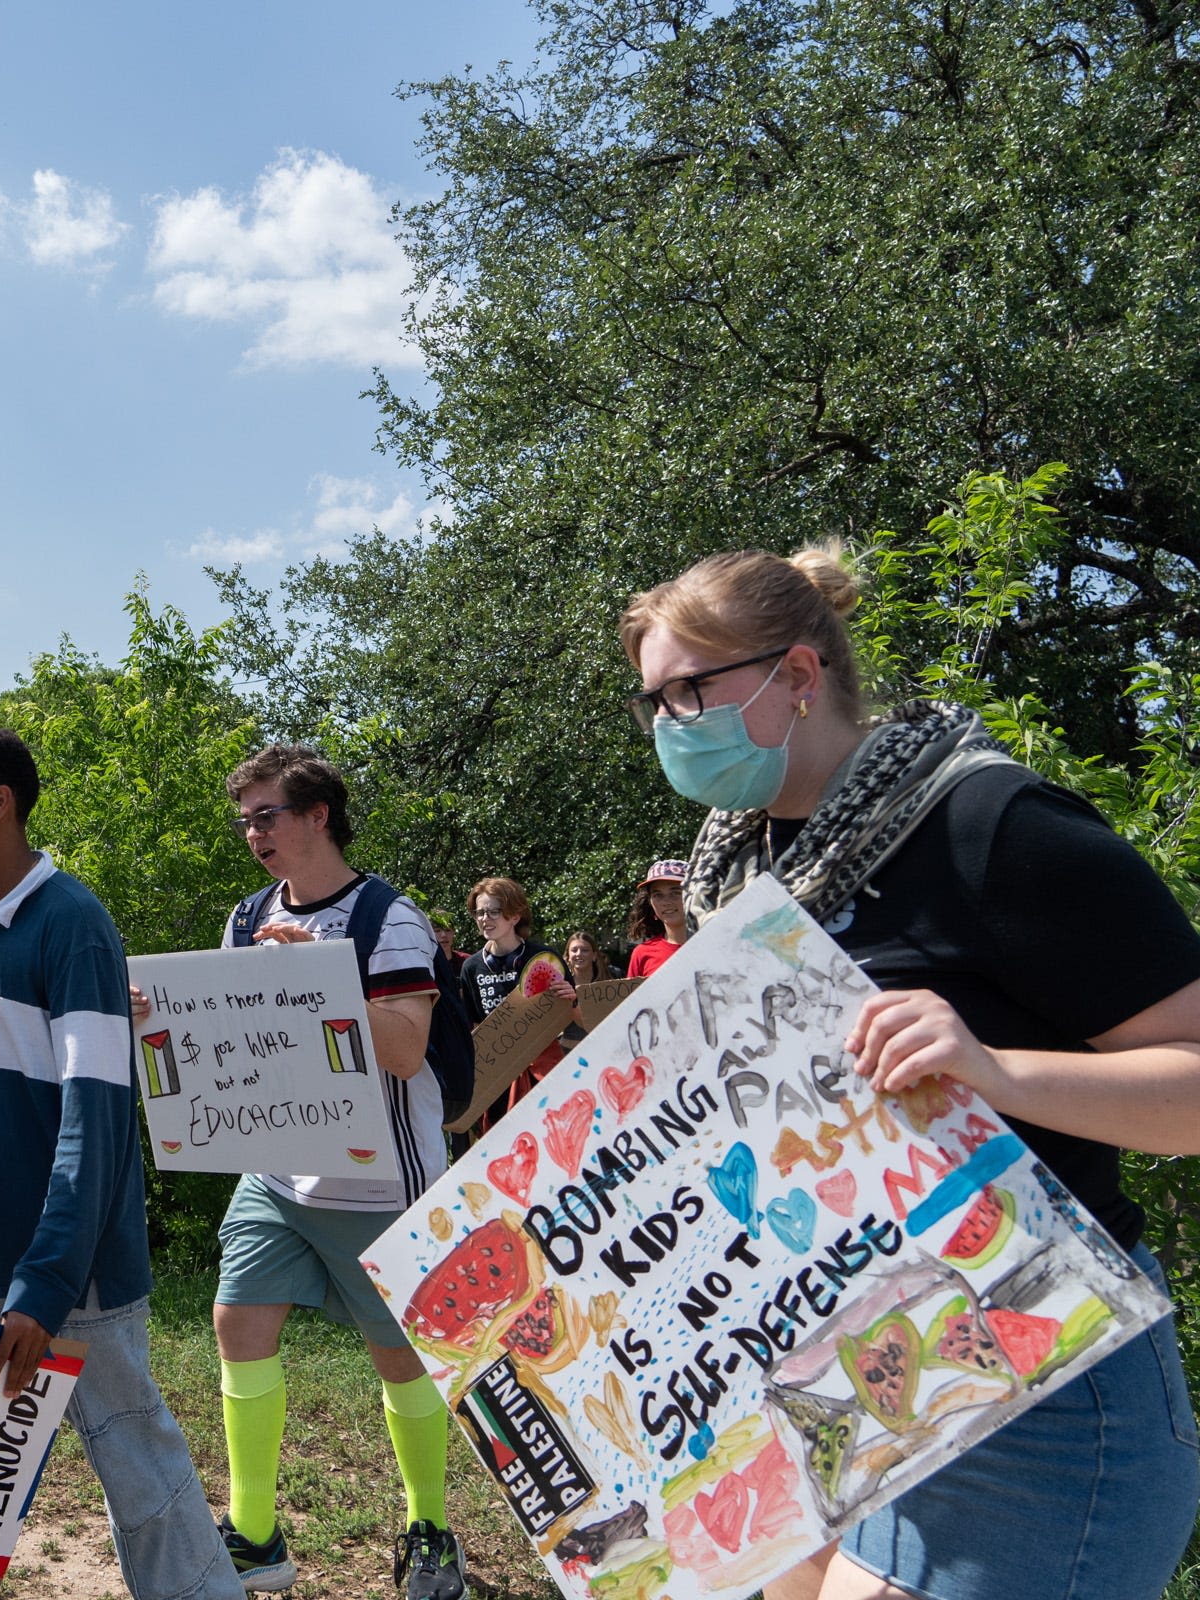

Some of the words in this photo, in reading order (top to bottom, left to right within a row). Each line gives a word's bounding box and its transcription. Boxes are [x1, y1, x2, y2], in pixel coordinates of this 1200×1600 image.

[476, 971, 518, 986] Gender
[479, 986, 487, 998] is
[487, 986, 495, 996] a
[153, 985, 196, 1015] How
[203, 998, 217, 1011] is
[226, 991, 265, 1010] there
[276, 988, 326, 1013] always
[481, 994, 506, 1010] Soci
[485, 1001, 516, 1031] WAR
[180, 1031, 201, 1066] $
[245, 1031, 298, 1058] WAR
[215, 1076, 234, 1091] but
[243, 1070, 260, 1086] not
[523, 1076, 719, 1276] BOMBING
[599, 1186, 704, 1287] KIDS
[610, 1327, 653, 1376] IS
[677, 1232, 761, 1332] NOT
[640, 1213, 902, 1461] SELF-DEFENSE
[485, 1363, 586, 1507] PALESTINE
[500, 1458, 555, 1530] FREE
